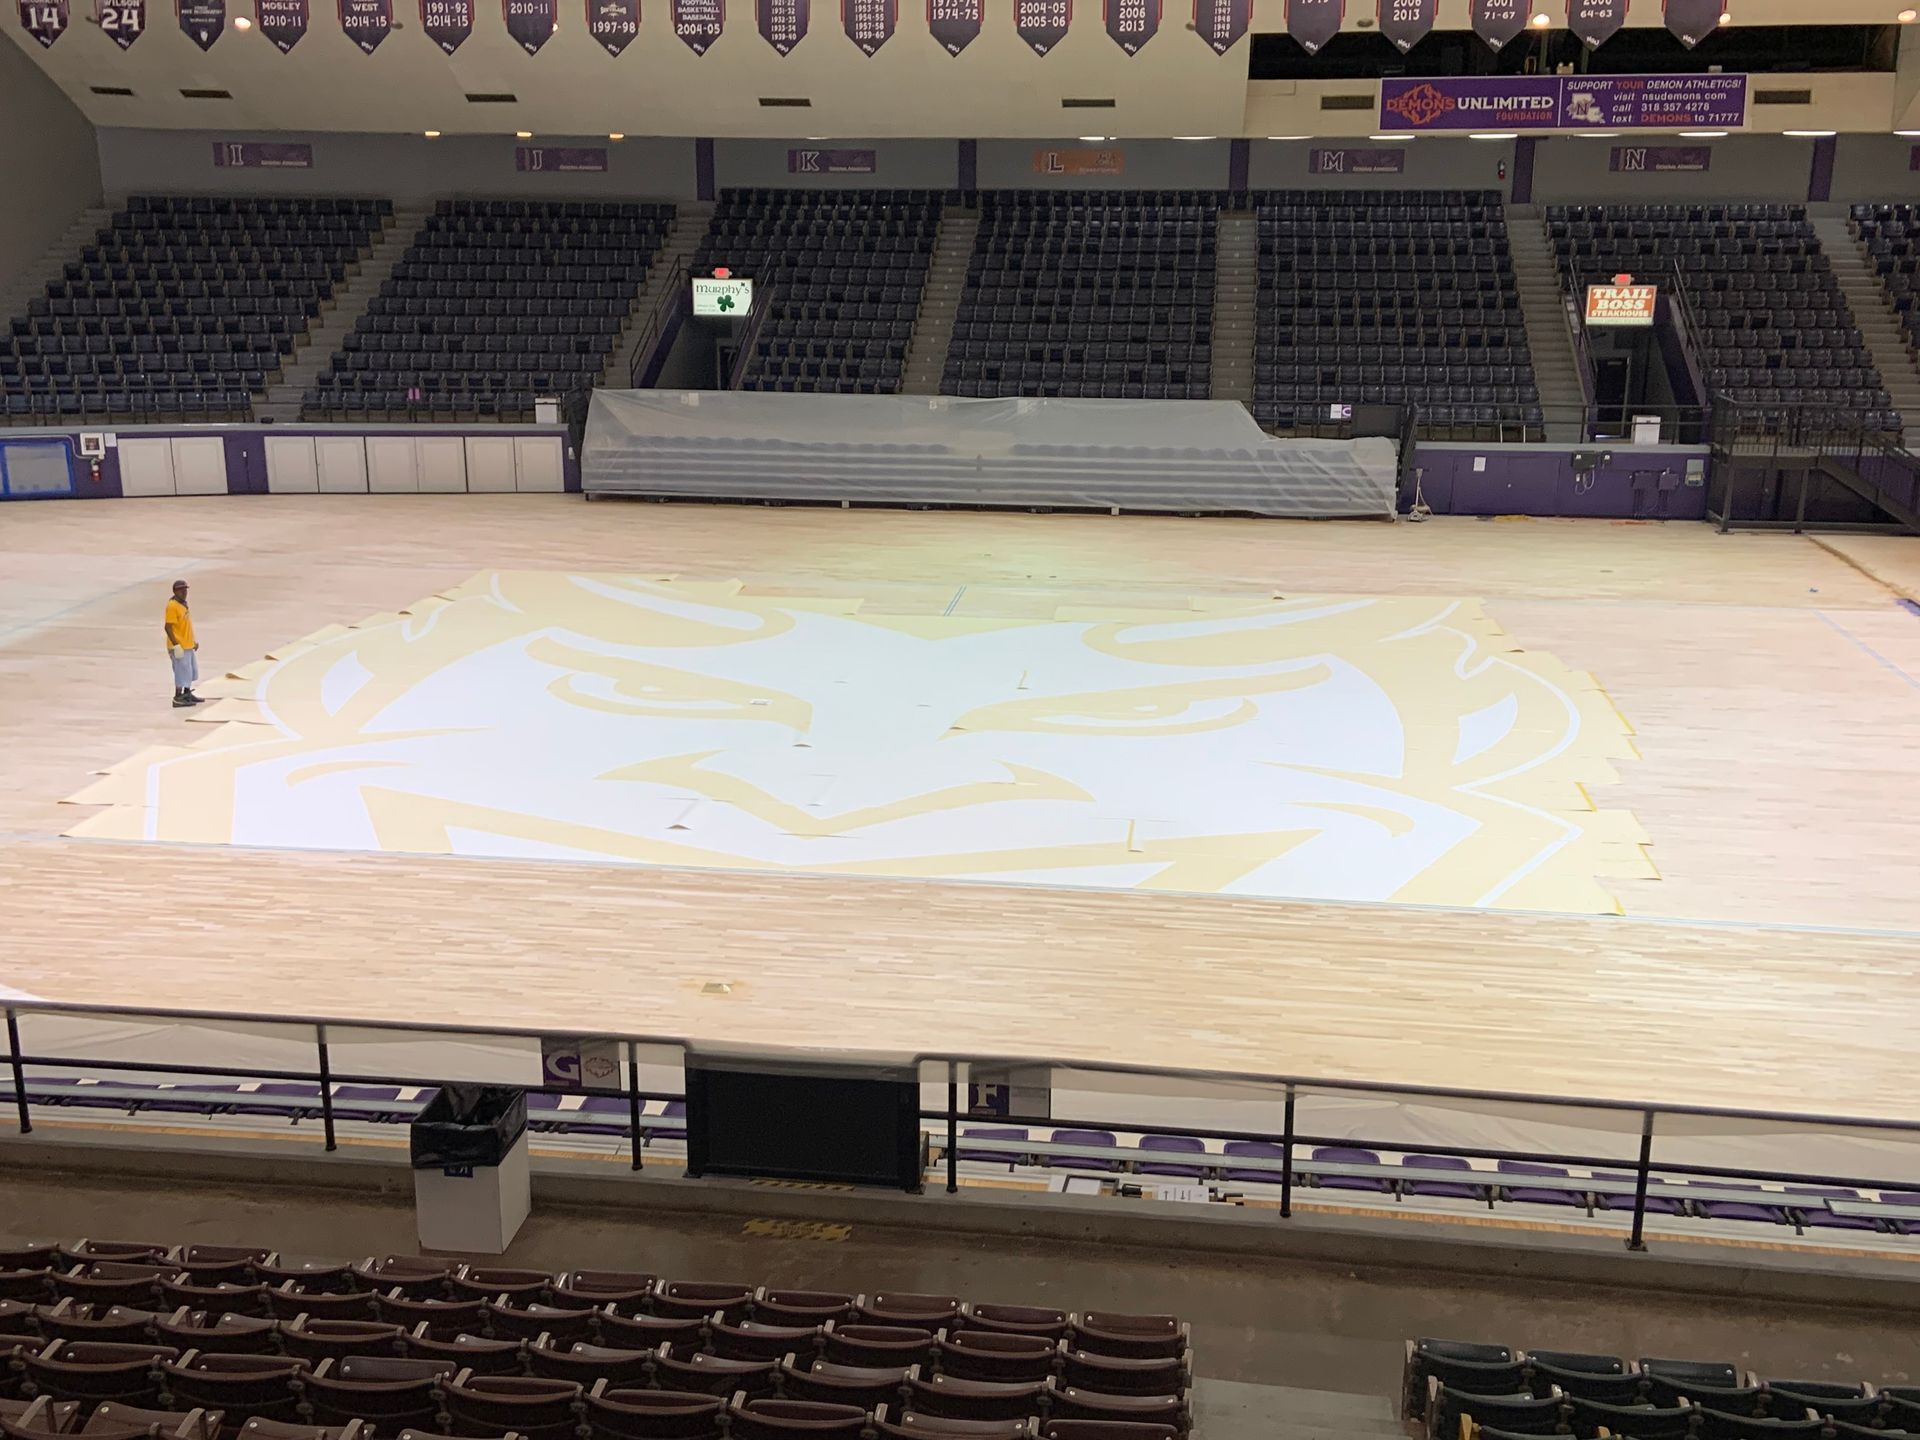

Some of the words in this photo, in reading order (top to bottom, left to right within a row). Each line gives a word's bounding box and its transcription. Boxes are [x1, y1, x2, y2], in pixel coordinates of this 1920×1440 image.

[262, 2, 301, 10] MOSLEY
[352, 3, 378, 11] WEST
[427, 3, 468, 14] 1991-92
[510, 3, 549, 14] 2010-11
[1020, 3, 1066, 14] 2004-05
[30, 7, 60, 29] 14
[933, 8, 978, 20] 1974-75
[1119, 7, 1146, 18] 2006
[1393, 9, 1420, 21] 2013
[1484, 11, 1516, 20] 71-67
[1580, 9, 1613, 18] 64-63
[102, 8, 140, 31] 24
[263, 15, 302, 27] 2010-11
[345, 16, 387, 27] 2014-15
[426, 15, 469, 27] 2014-15
[1020, 16, 1066, 27] 2005-06
[593, 22, 636, 33] 1997-98
[677, 24, 720, 35] 2004-05
[855, 22, 884, 31] 1957-58
[1119, 20, 1145, 31] 2013
[855, 31, 885, 40] 1959-60
[1567, 81, 1613, 91] SUPPORT
[1616, 80, 1644, 90] YOUR
[1647, 80, 1683, 90] DEMON
[1685, 79, 1742, 89] ATHLETICS!
[1613, 92, 1635, 101] visit
[1386, 97, 1455, 111] DEMONS
[1457, 96, 1554, 110] UNLIMITED
[1612, 103, 1632, 112] call
[1641, 102, 1660, 112] 318
[1663, 102, 1681, 112] 357
[1684, 102, 1710, 112] 4278
[1496, 112, 1553, 121] FOUNDATION
[1612, 114, 1632, 123] text
[1641, 113, 1691, 123] DEMONS
[1694, 114, 1705, 122] to
[1708, 113, 1739, 122] 71777
[801, 151, 820, 172] K
[1048, 152, 1065, 173] L
[1323, 151, 1344, 172] M
[1625, 149, 1647, 170] N
[696, 282, 750, 296] Murphy's
[1593, 288, 1652, 299] TRAIL
[1596, 299, 1646, 310] BOSS
[1591, 309, 1649, 317] STEAKHOUSE
[546, 1050, 580, 1081] G
[976, 1082, 998, 1107] F
